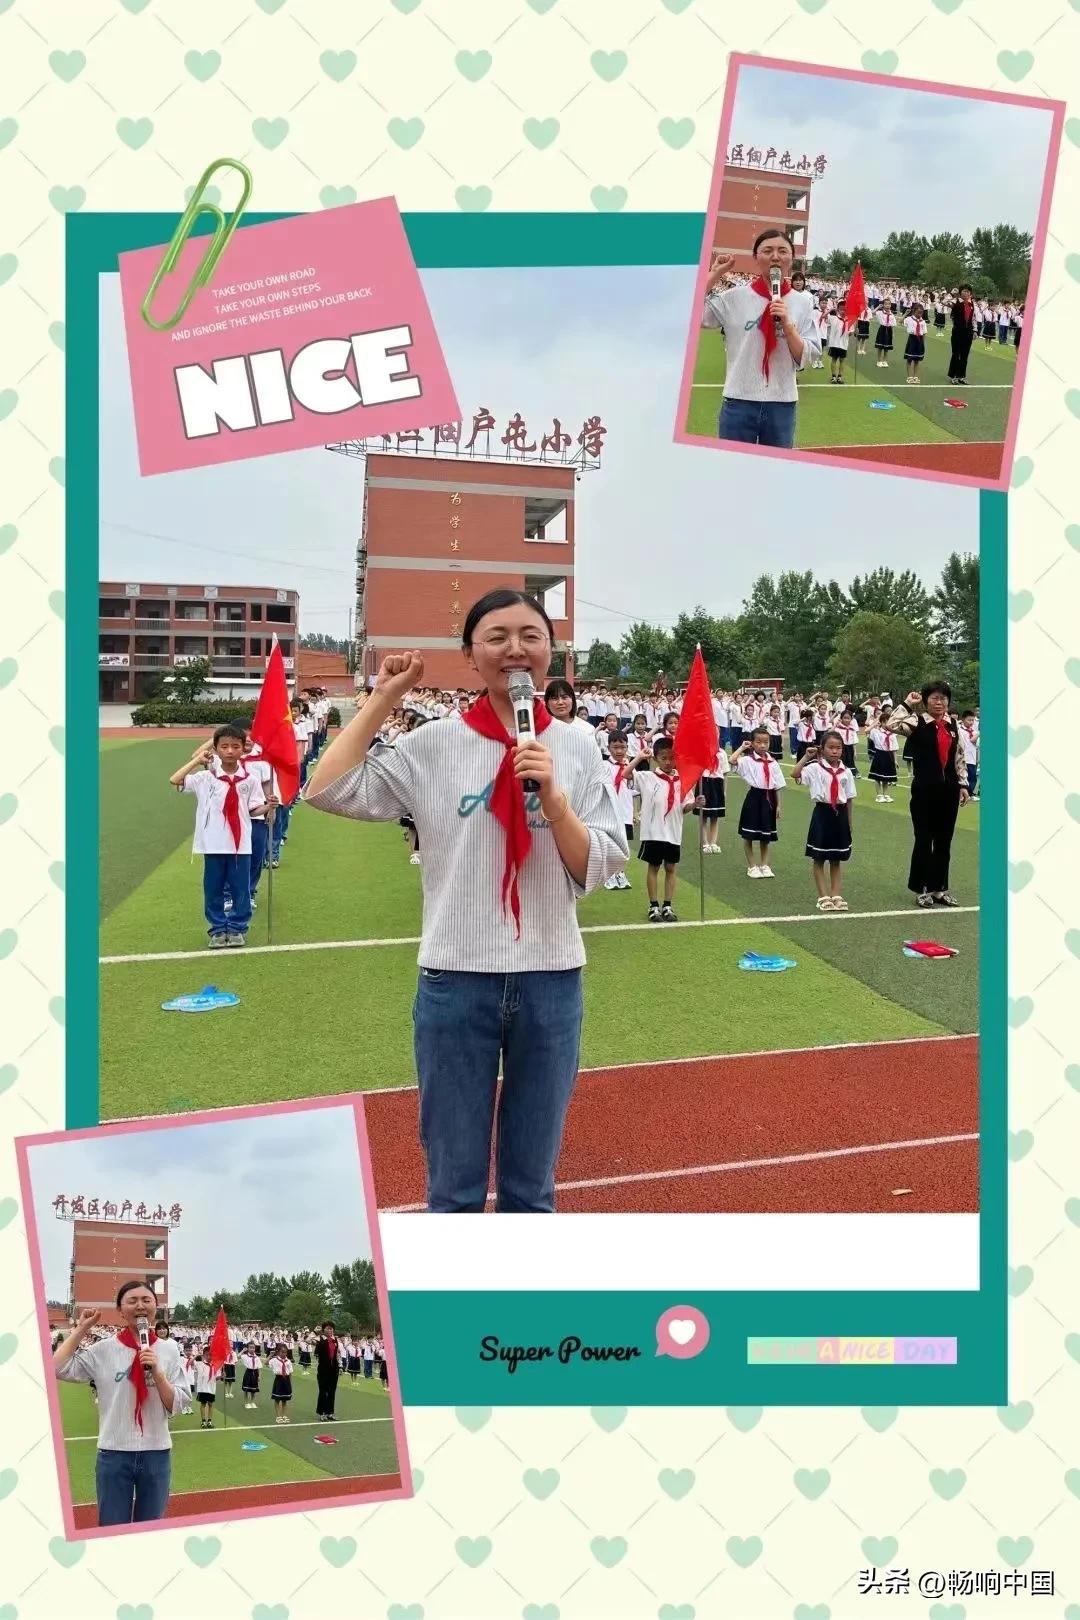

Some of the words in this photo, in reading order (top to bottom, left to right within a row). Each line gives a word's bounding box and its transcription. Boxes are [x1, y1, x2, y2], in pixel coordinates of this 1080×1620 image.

[726, 143, 828, 174] 区佃户屯小学
[381, 406, 608, 458] 佃户屯小学
[52, 1194, 183, 1222] 开发区佃户屯小学
